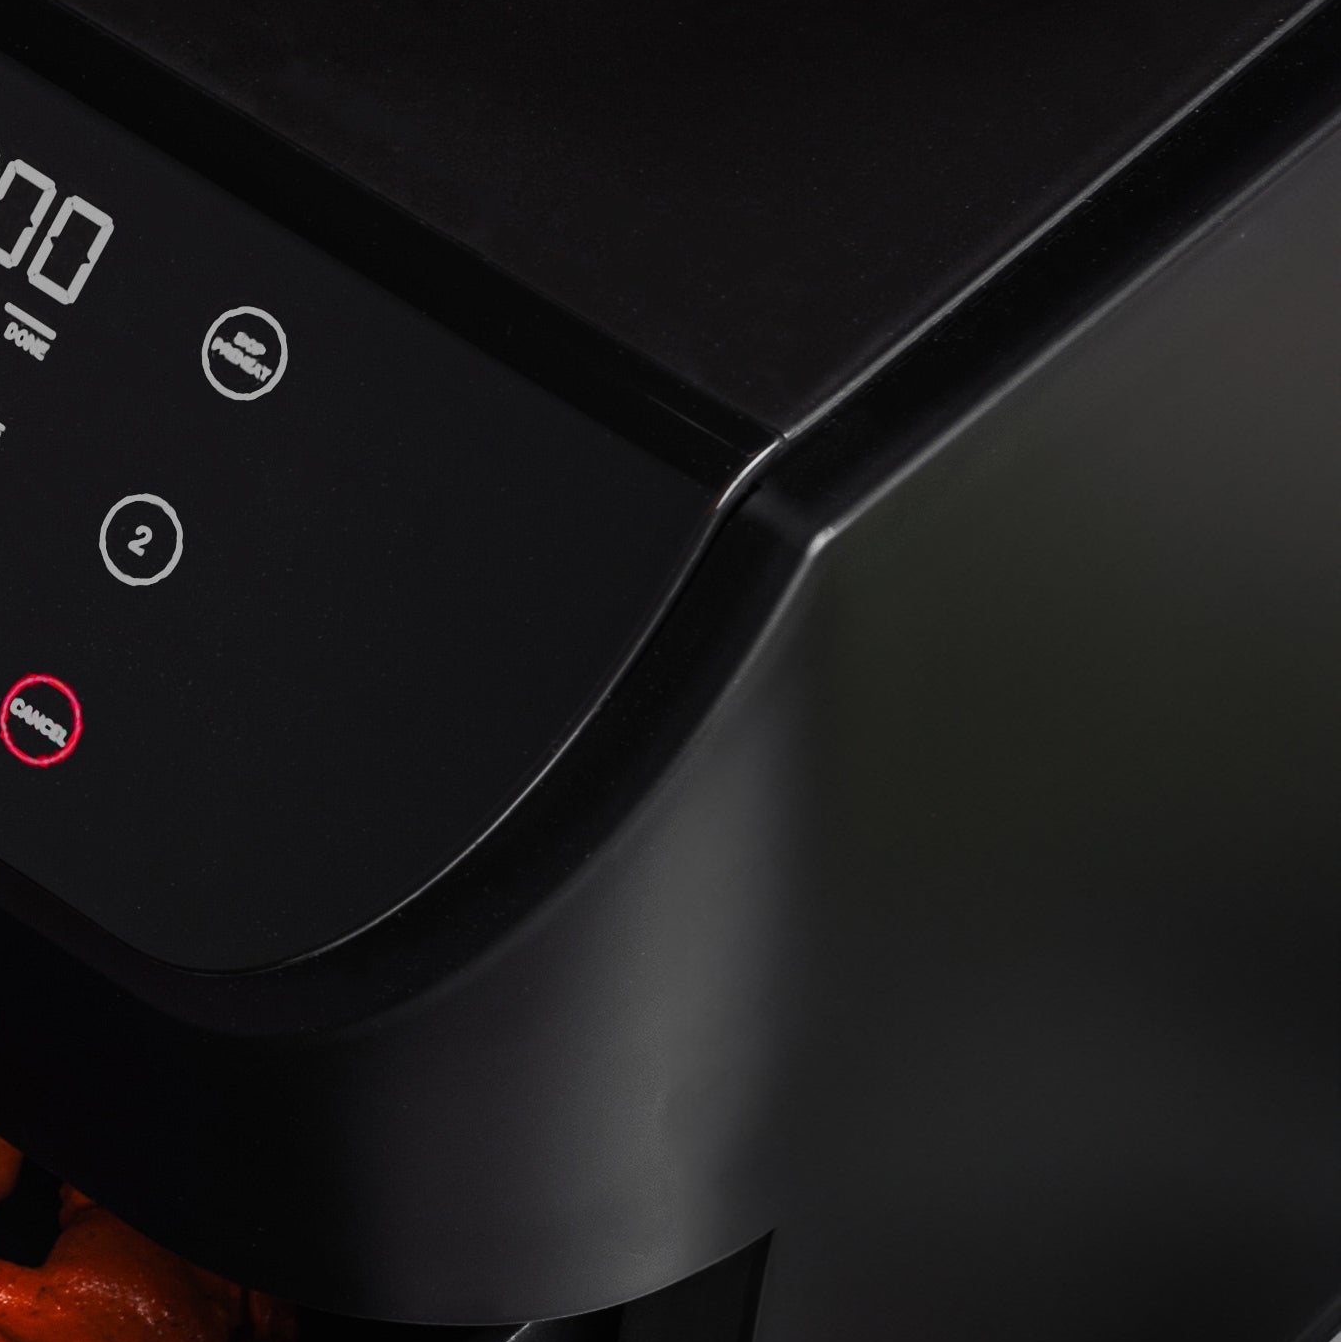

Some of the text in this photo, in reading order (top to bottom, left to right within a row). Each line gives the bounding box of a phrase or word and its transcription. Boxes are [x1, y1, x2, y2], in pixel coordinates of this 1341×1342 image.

[3, 321, 51, 362] DONE
[127, 524, 153, 557] 2
[9, 697, 67, 748] CANCEL
